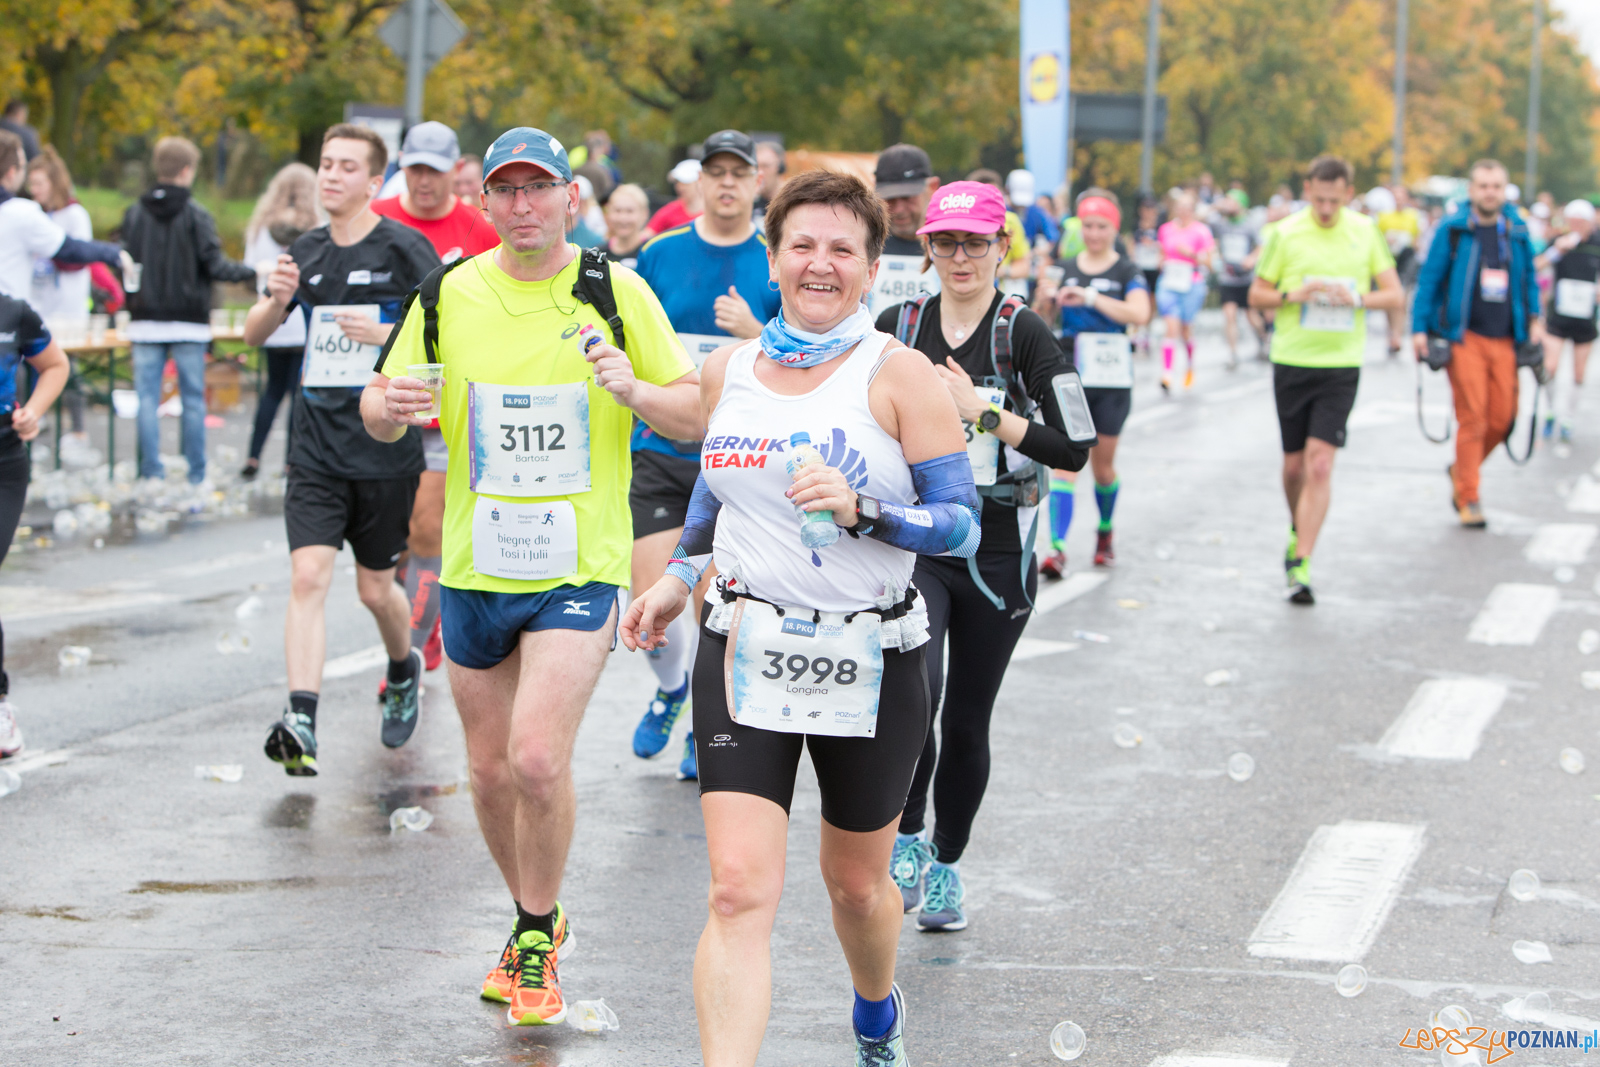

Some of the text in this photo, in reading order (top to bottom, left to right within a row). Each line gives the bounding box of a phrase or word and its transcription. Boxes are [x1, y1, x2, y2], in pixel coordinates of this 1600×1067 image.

[939, 193, 976, 210] ciele
[500, 423, 566, 452] 3112
[703, 435, 789, 453] HERNIK
[515, 454, 550, 463] Bartosz
[705, 453, 768, 470] TEAM
[497, 532, 551, 548] biegnę dla
[500, 548, 548, 562] Tosi i Julii
[761, 649, 858, 685] 3998
[786, 684, 829, 696] Longina
[807, 711, 822, 719] 4F
